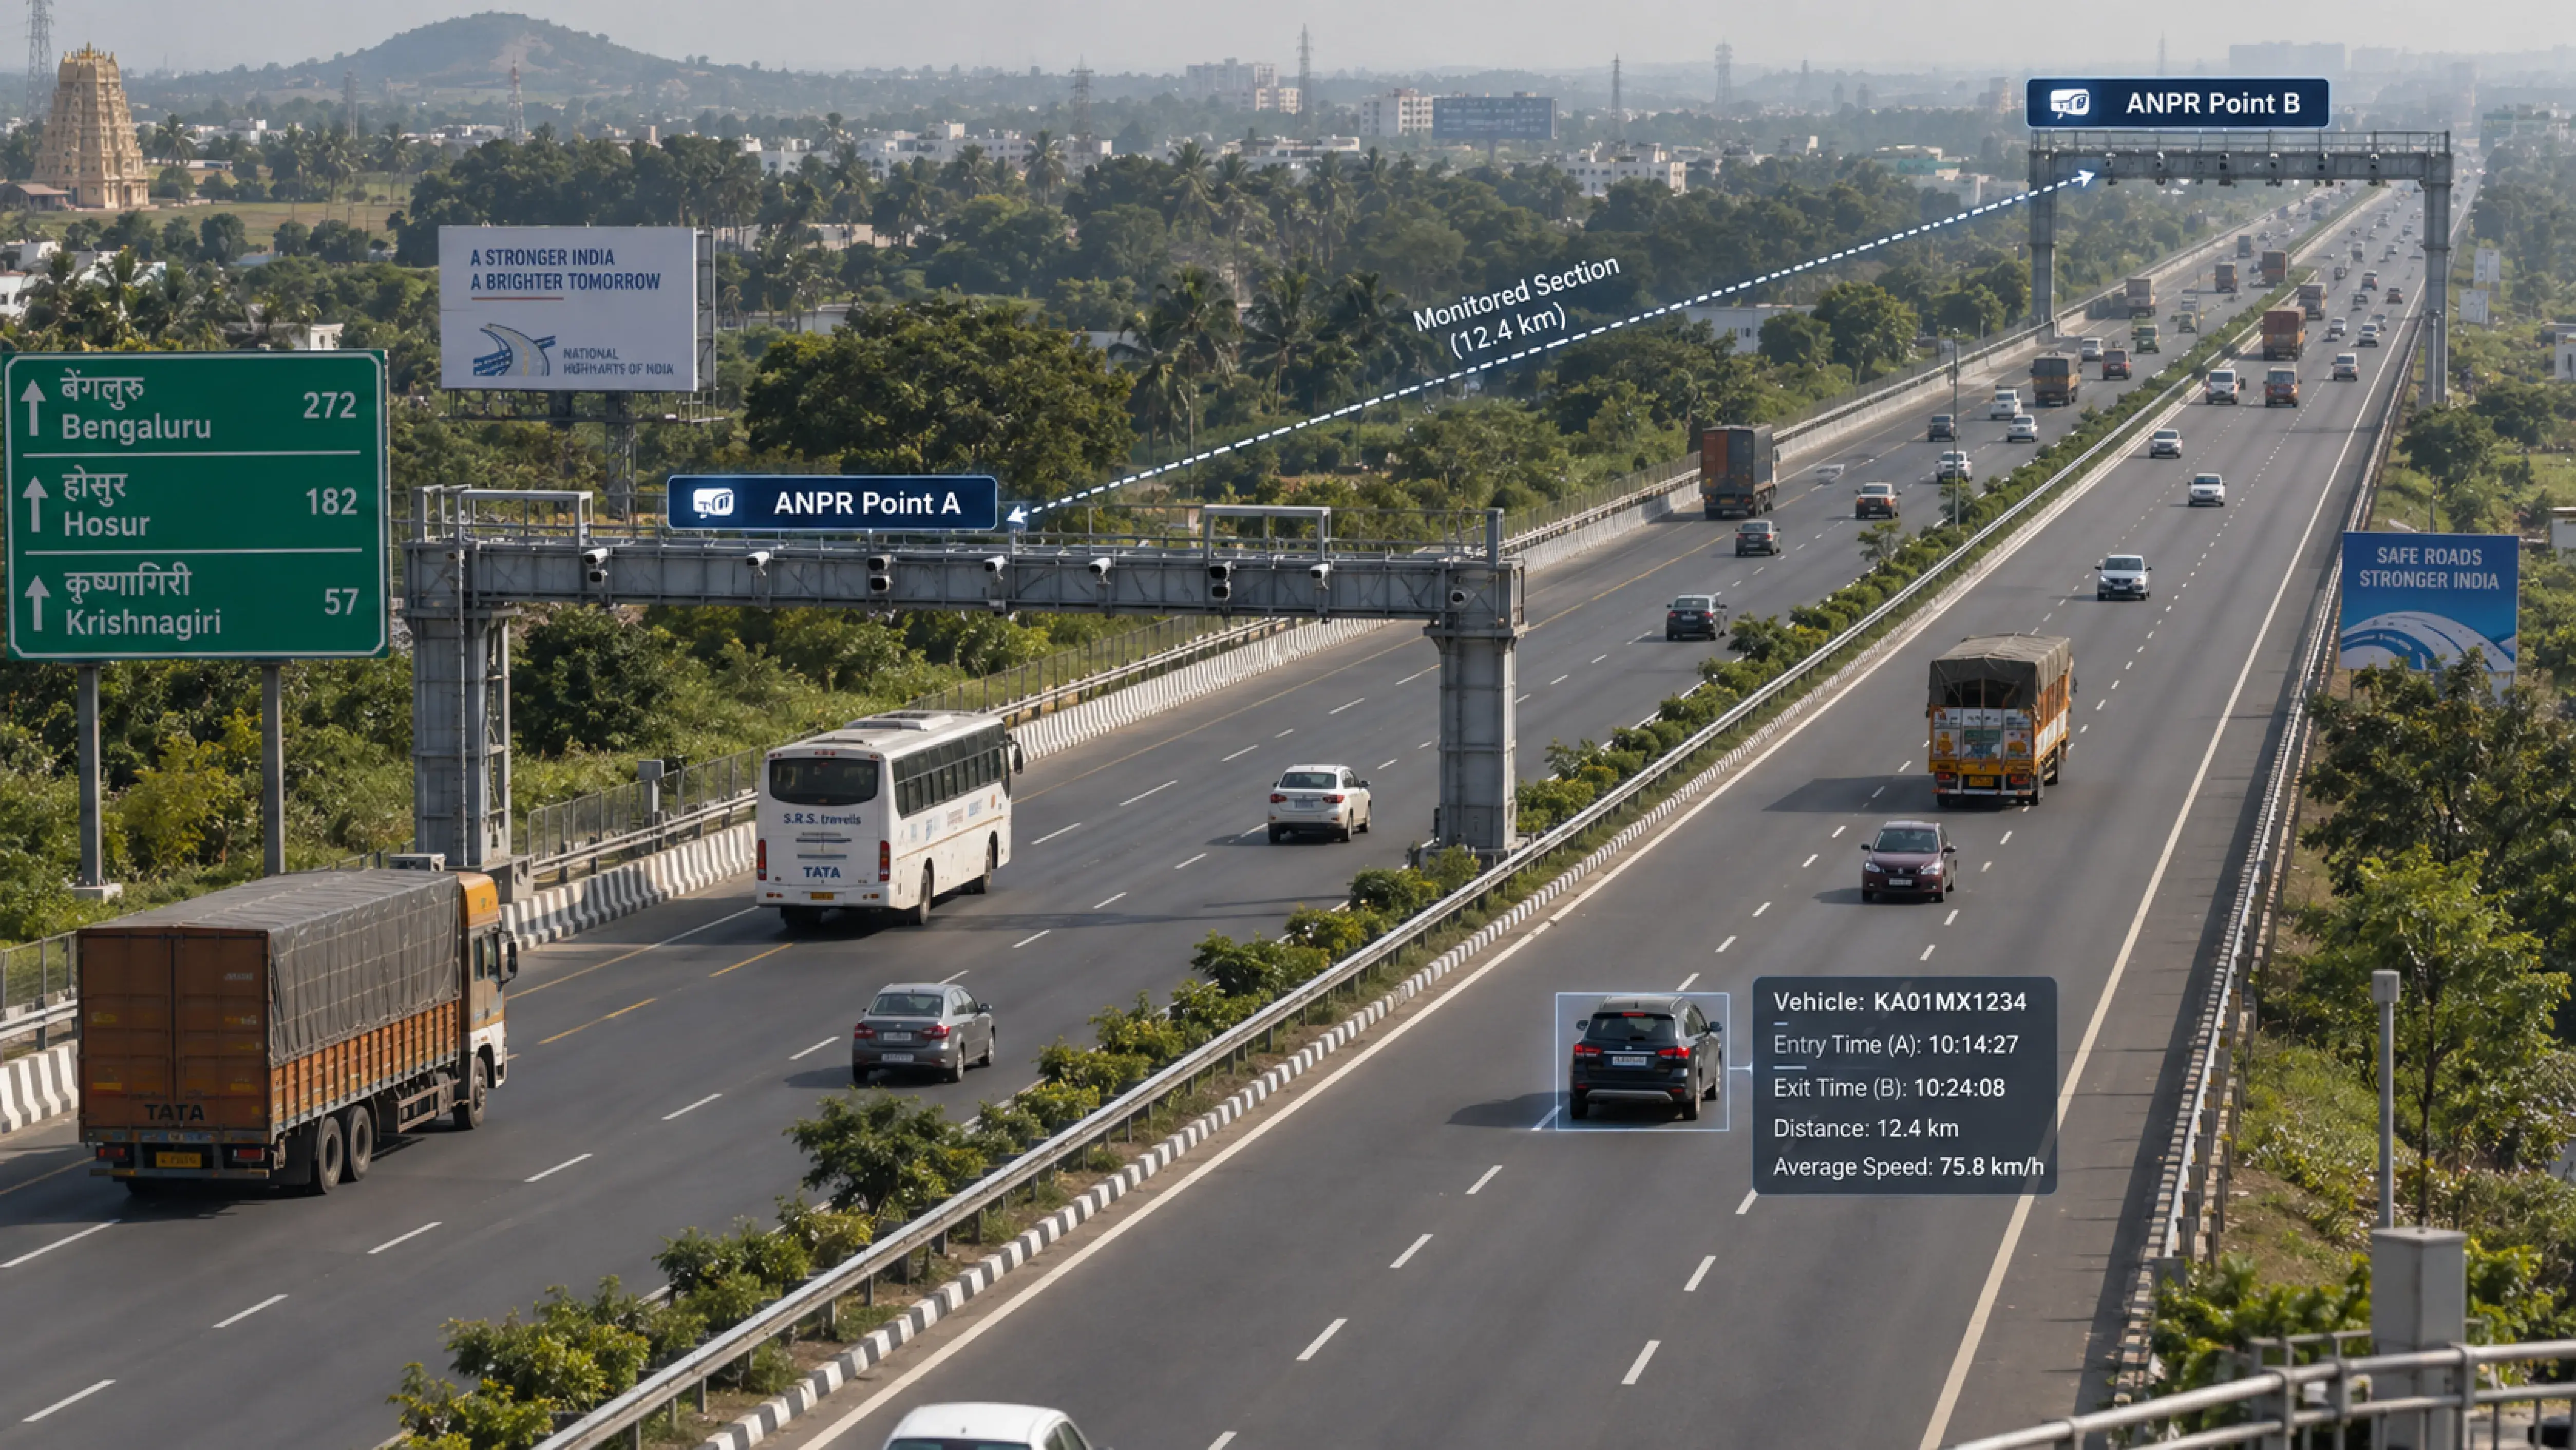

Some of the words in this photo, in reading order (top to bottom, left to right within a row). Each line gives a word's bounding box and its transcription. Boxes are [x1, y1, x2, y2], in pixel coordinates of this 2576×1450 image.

[470, 249, 481, 266] A
[486, 249, 567, 266] STRONGER
[573, 249, 615, 266] INDIA
[471, 272, 481, 290] A
[486, 272, 563, 290] BRIGHTER
[568, 272, 661, 290] TOMORROW
[60, 368, 144, 410] बेंगलुरु
[303, 391, 356, 419] 272
[62, 413, 211, 445] Bengaluru
[62, 465, 128, 507] होसुर
[307, 488, 358, 515] 182
[64, 511, 150, 537] Hosur
[2376, 547, 2419, 564] SAFE
[2424, 548, 2484, 566] ROADS
[2360, 570, 2448, 588] STRONGER
[2453, 571, 2499, 590] INDIA
[325, 588, 359, 615] 57
[66, 608, 221, 642] Krishnagiri
[802, 866, 841, 879] TATA
[144, 1104, 205, 1121] TATA
